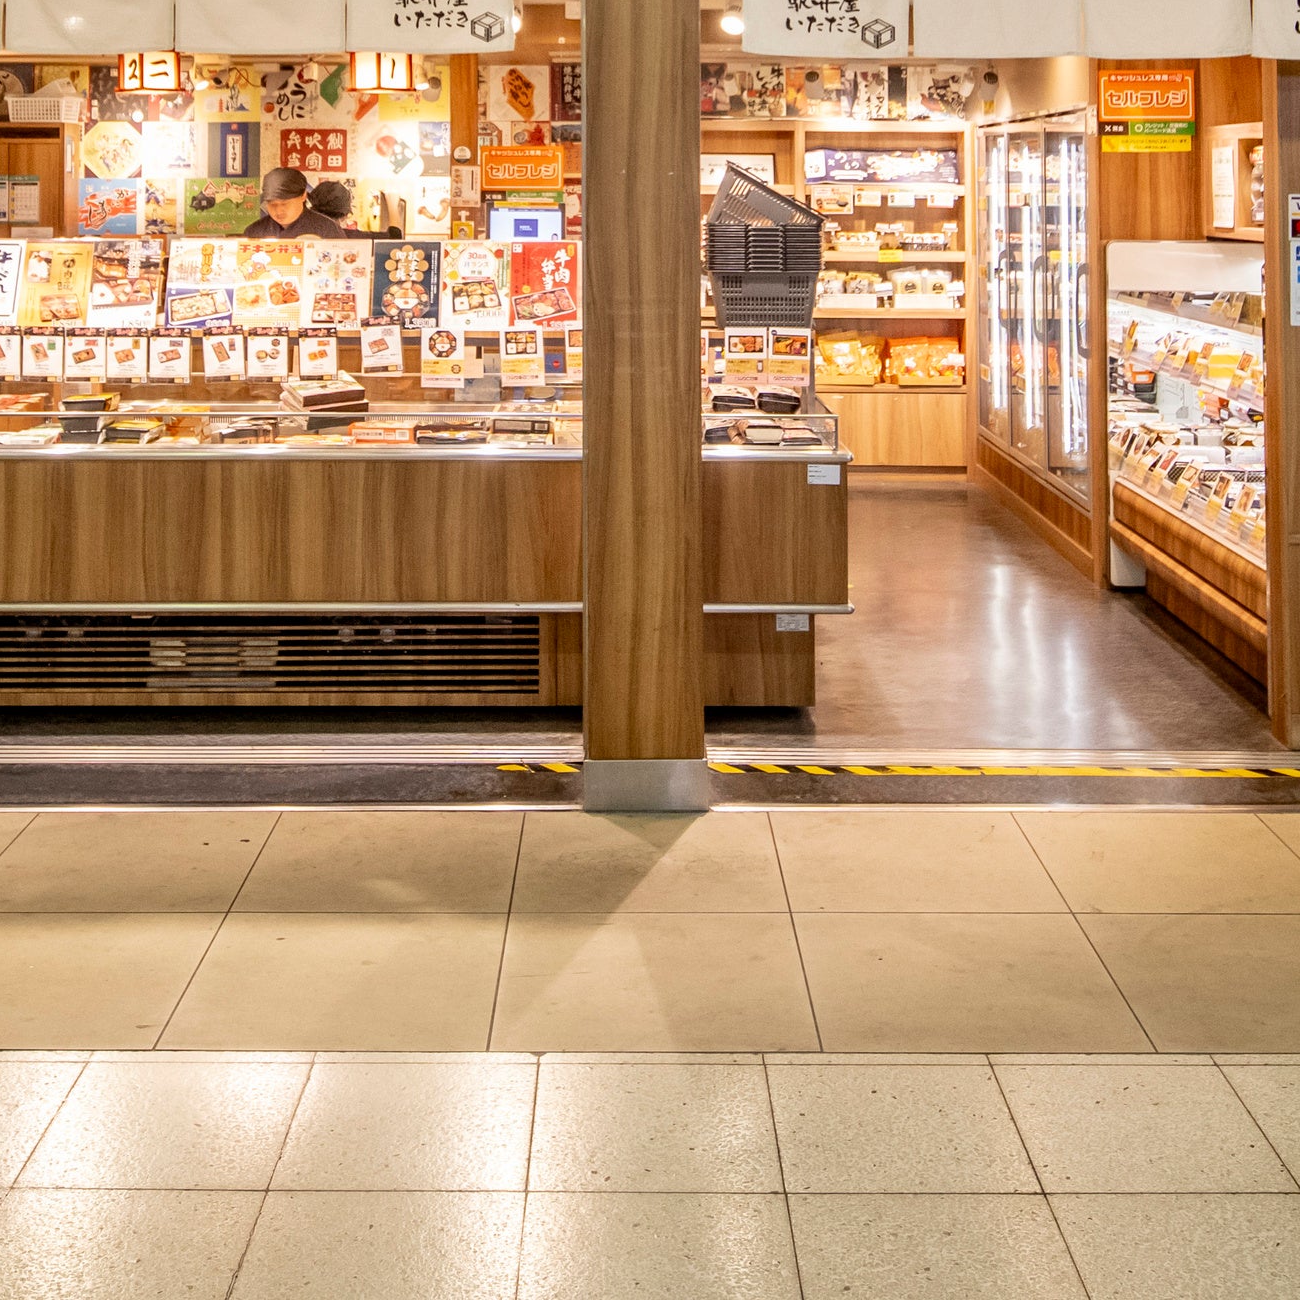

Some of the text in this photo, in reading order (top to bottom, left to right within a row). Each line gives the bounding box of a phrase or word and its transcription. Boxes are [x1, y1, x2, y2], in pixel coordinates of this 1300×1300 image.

[394, 10, 468, 28] いただき
[786, 15, 860, 33] いただき
[128, 58, 170, 81] 2 二
[290, 82, 307, 120] うに
[1107, 90, 1187, 108] セルフレジ
[487, 163, 558, 180] セルフレジ
[239, 244, 303, 254] チキン弁当
[541, 257, 555, 290] 弁当
[554, 248, 571, 285] 牛肉
